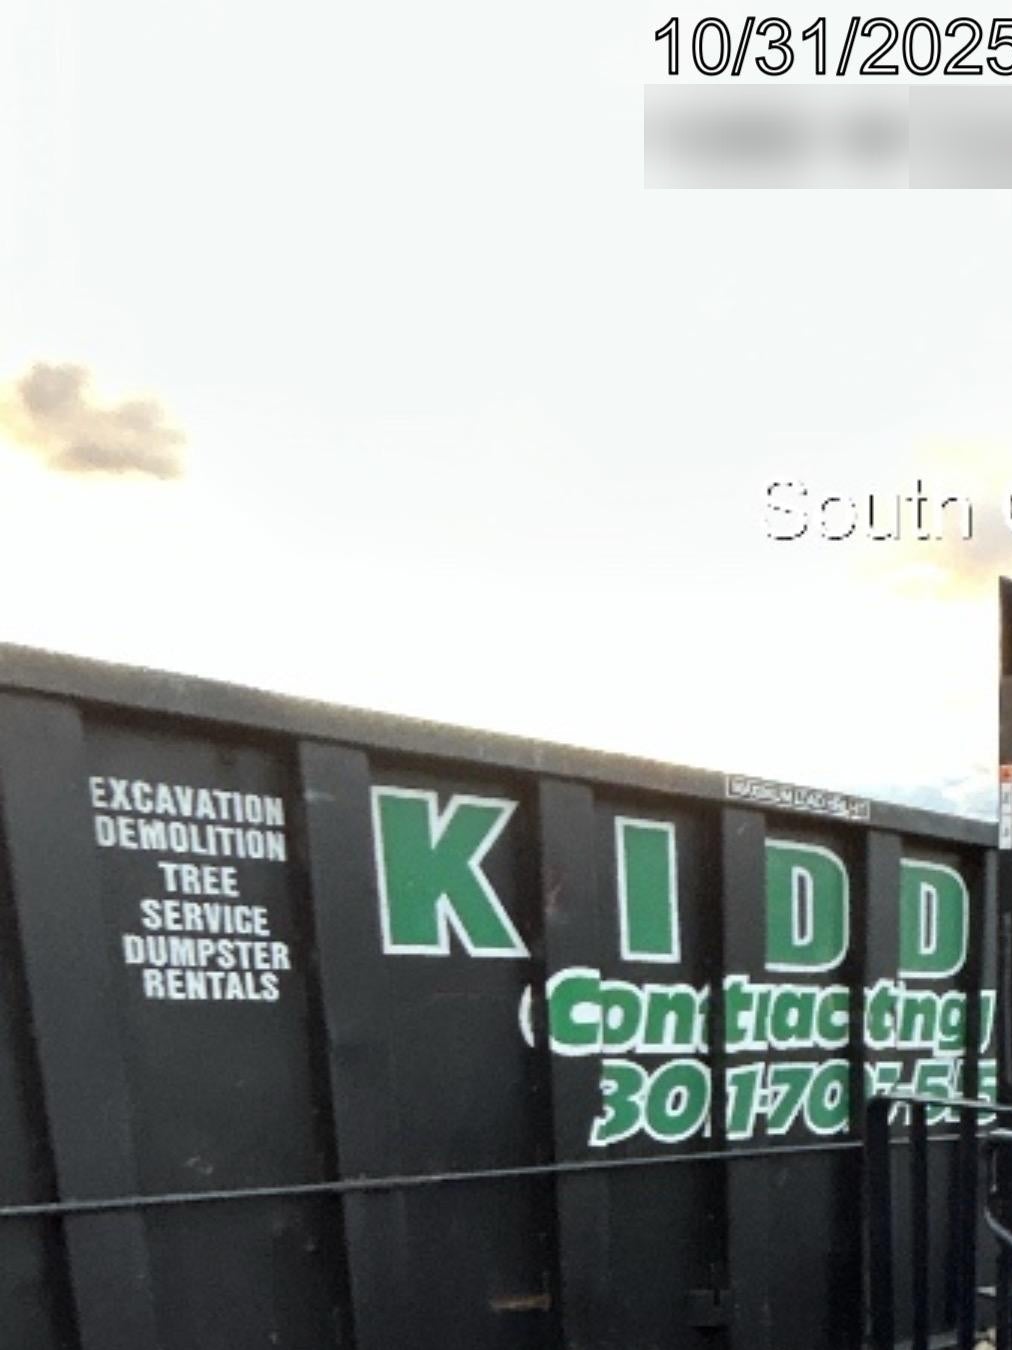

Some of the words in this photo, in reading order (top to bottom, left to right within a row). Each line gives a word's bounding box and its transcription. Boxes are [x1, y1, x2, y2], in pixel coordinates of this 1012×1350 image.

[89, 777, 285, 826] EXCAVATION
[95, 815, 286, 861] DEMOLITION
[158, 861, 240, 897] TREE
[140, 899, 271, 937] SERVICE
[122, 933, 291, 970] DUMPSTER
[142, 969, 280, 1002] RENTALS
